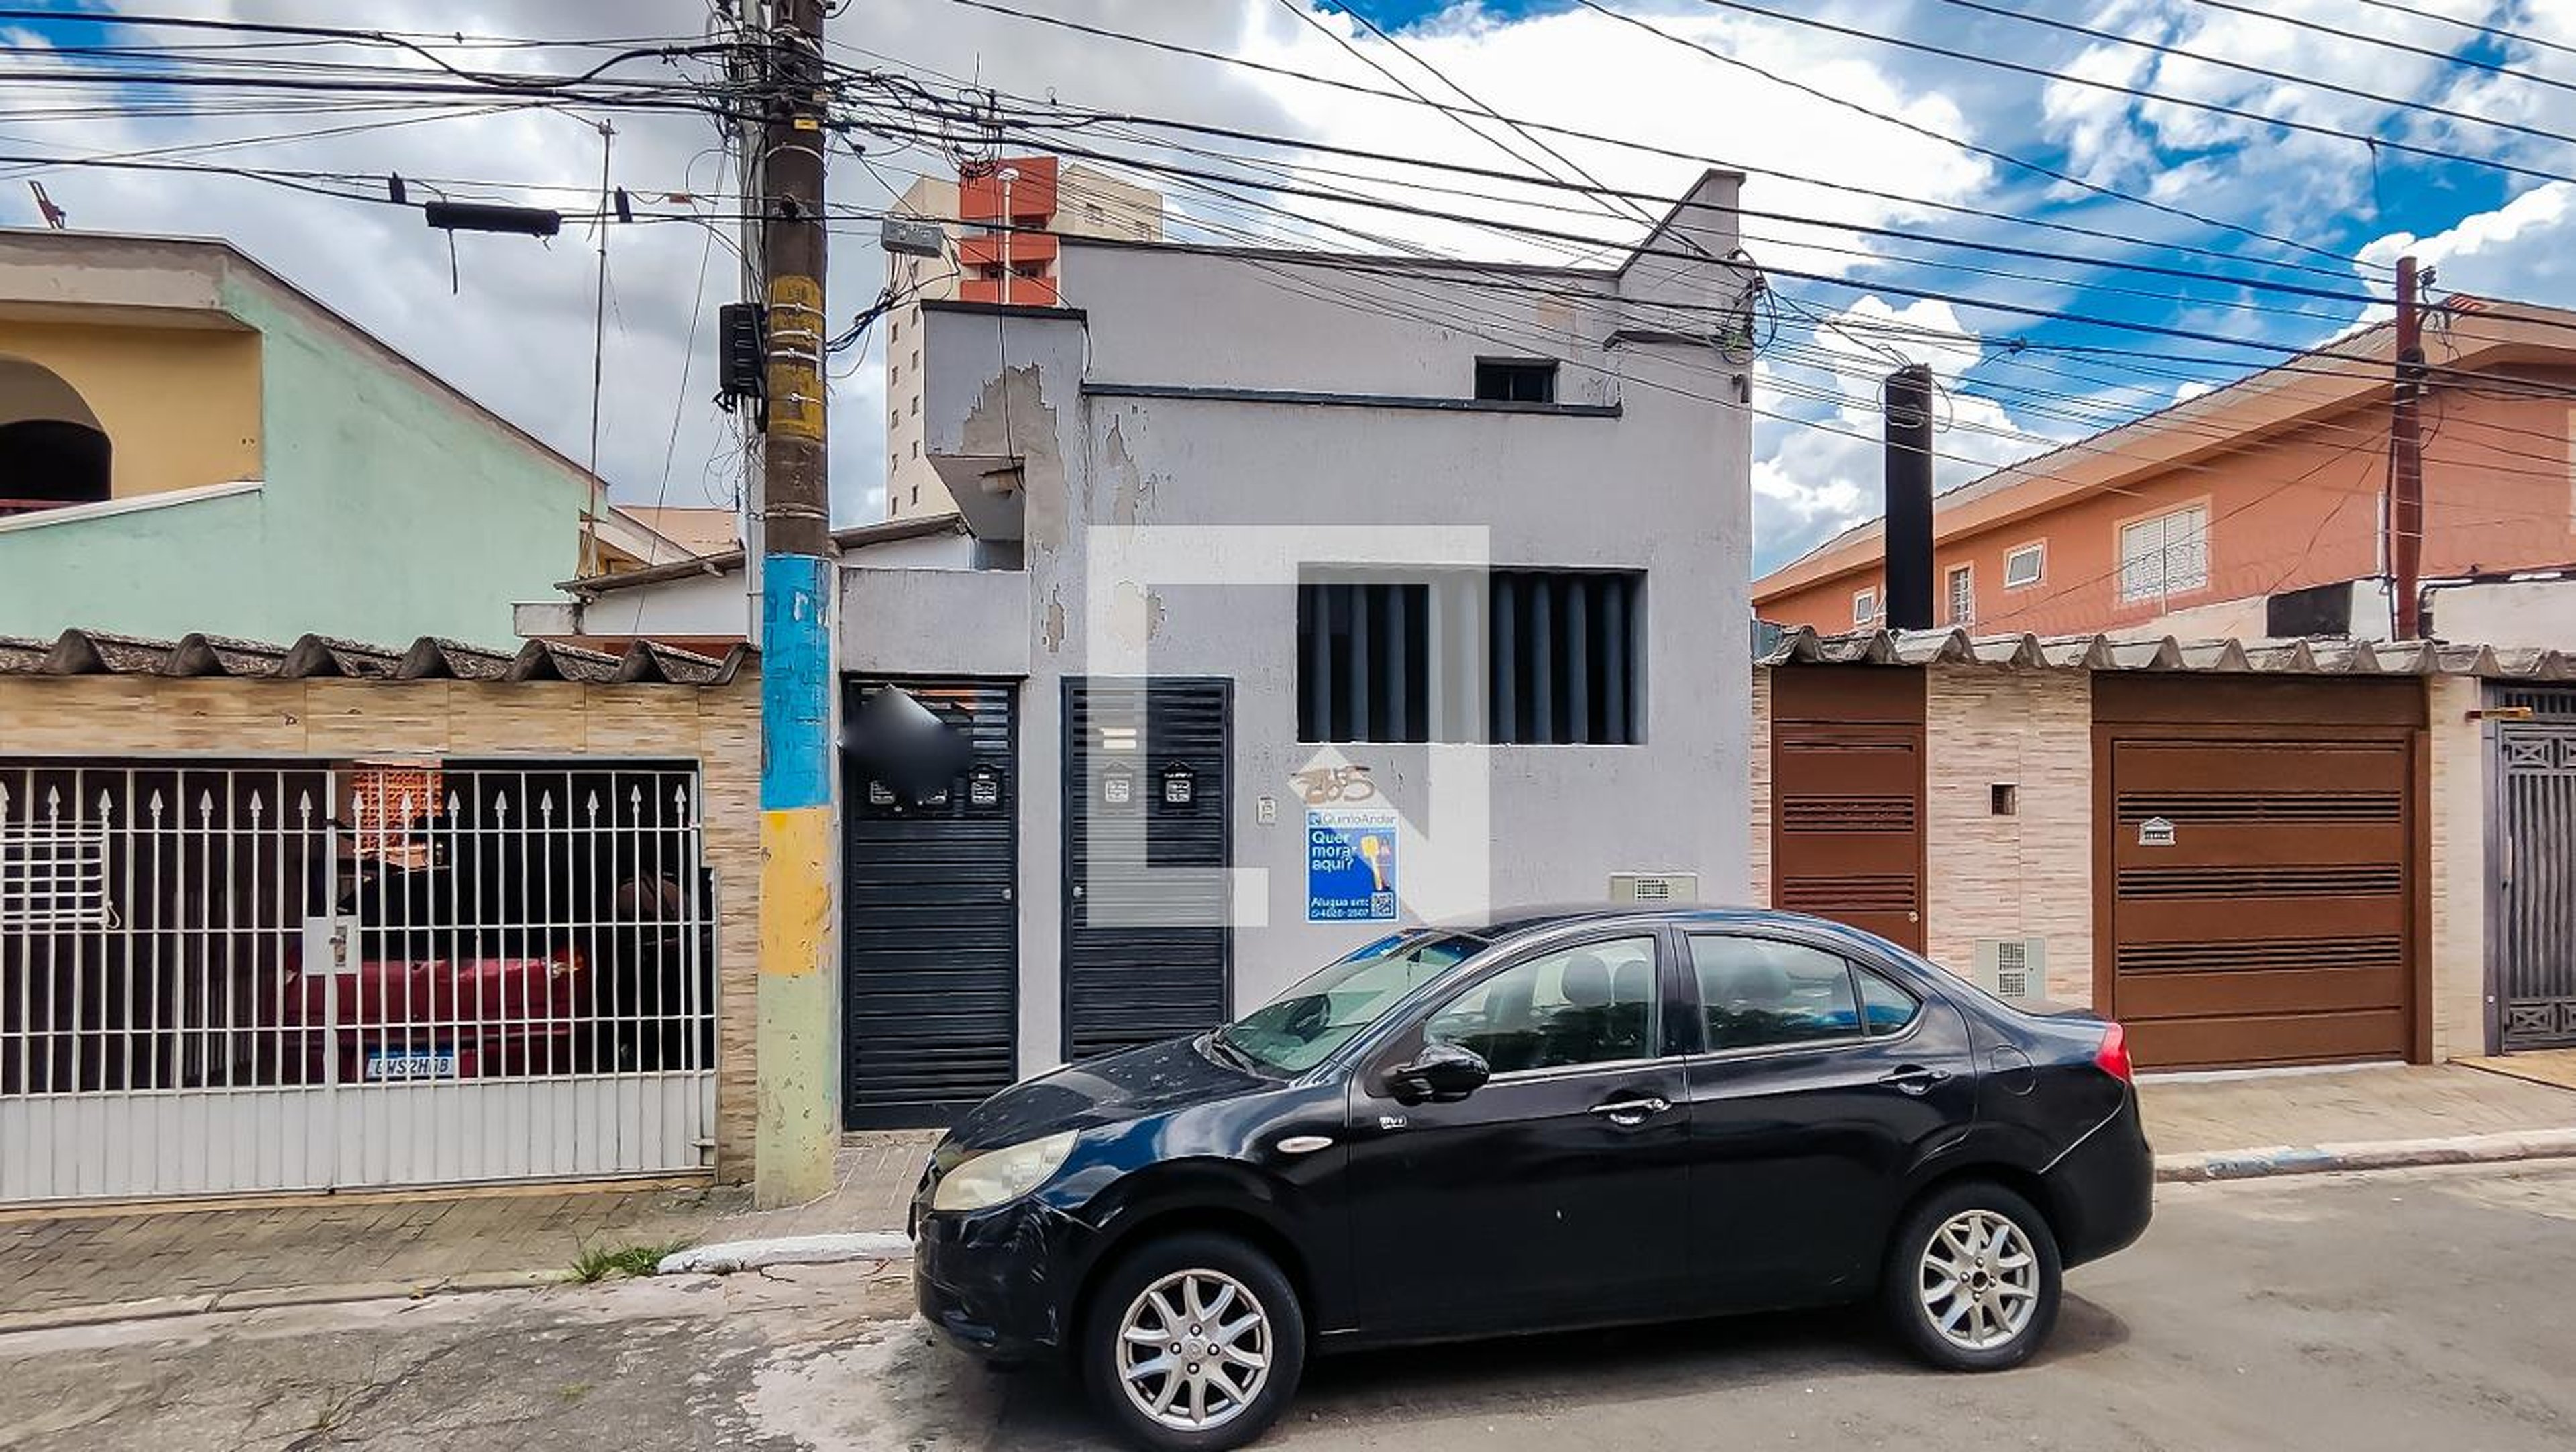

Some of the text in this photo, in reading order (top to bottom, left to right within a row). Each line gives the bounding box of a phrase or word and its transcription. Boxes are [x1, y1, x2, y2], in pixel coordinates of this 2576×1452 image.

[1312, 831, 1350, 845] Quer
[1312, 846, 1358, 858] morar
[1312, 857, 1354, 873] aqui?
